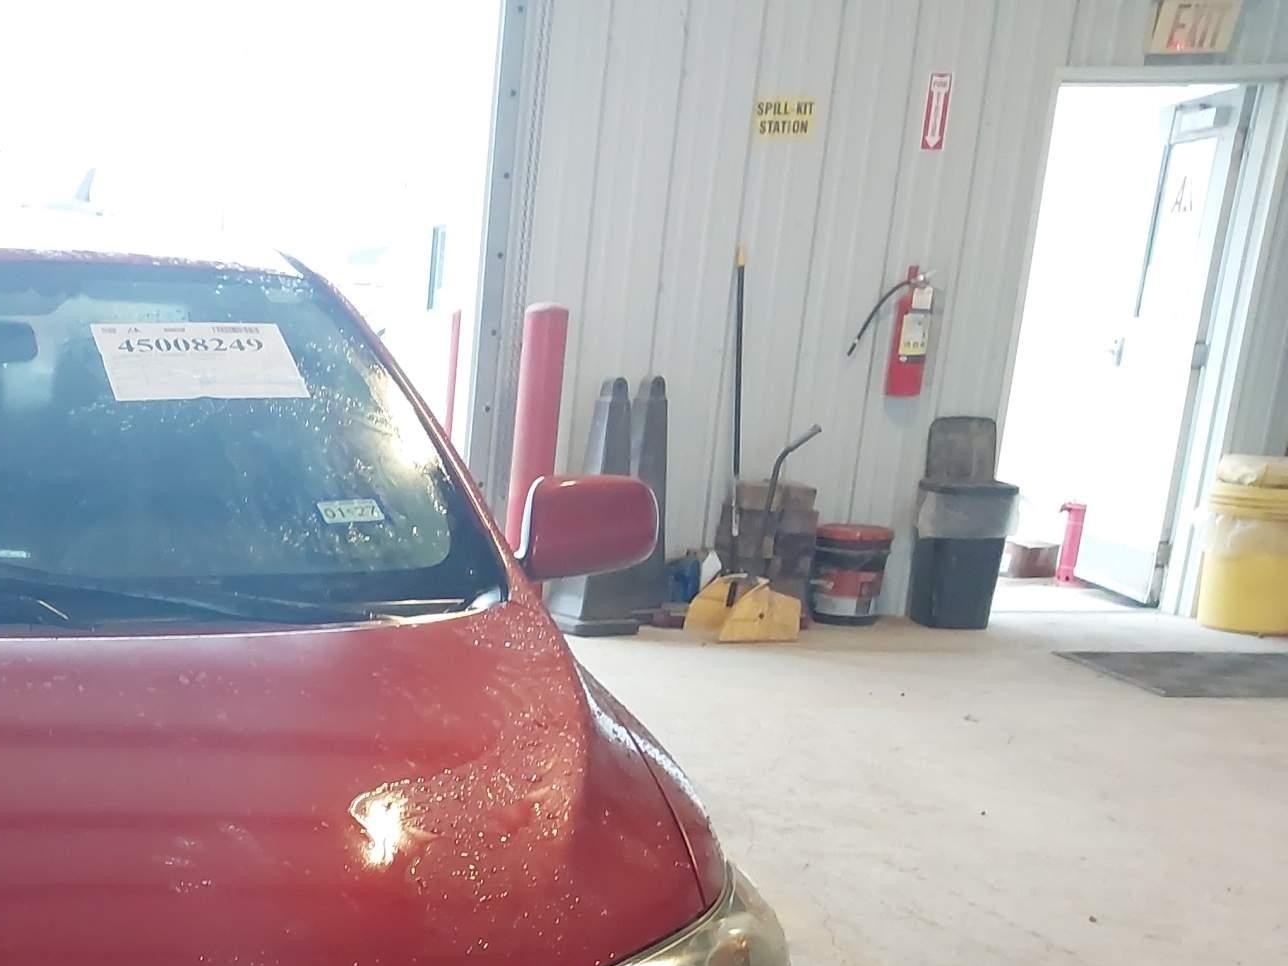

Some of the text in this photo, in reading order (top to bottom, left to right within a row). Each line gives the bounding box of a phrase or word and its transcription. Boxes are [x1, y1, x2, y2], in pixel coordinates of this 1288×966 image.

[756, 102, 815, 116] SPILL KIT
[759, 120, 809, 135] STATION
[118, 337, 264, 353] 45008249
